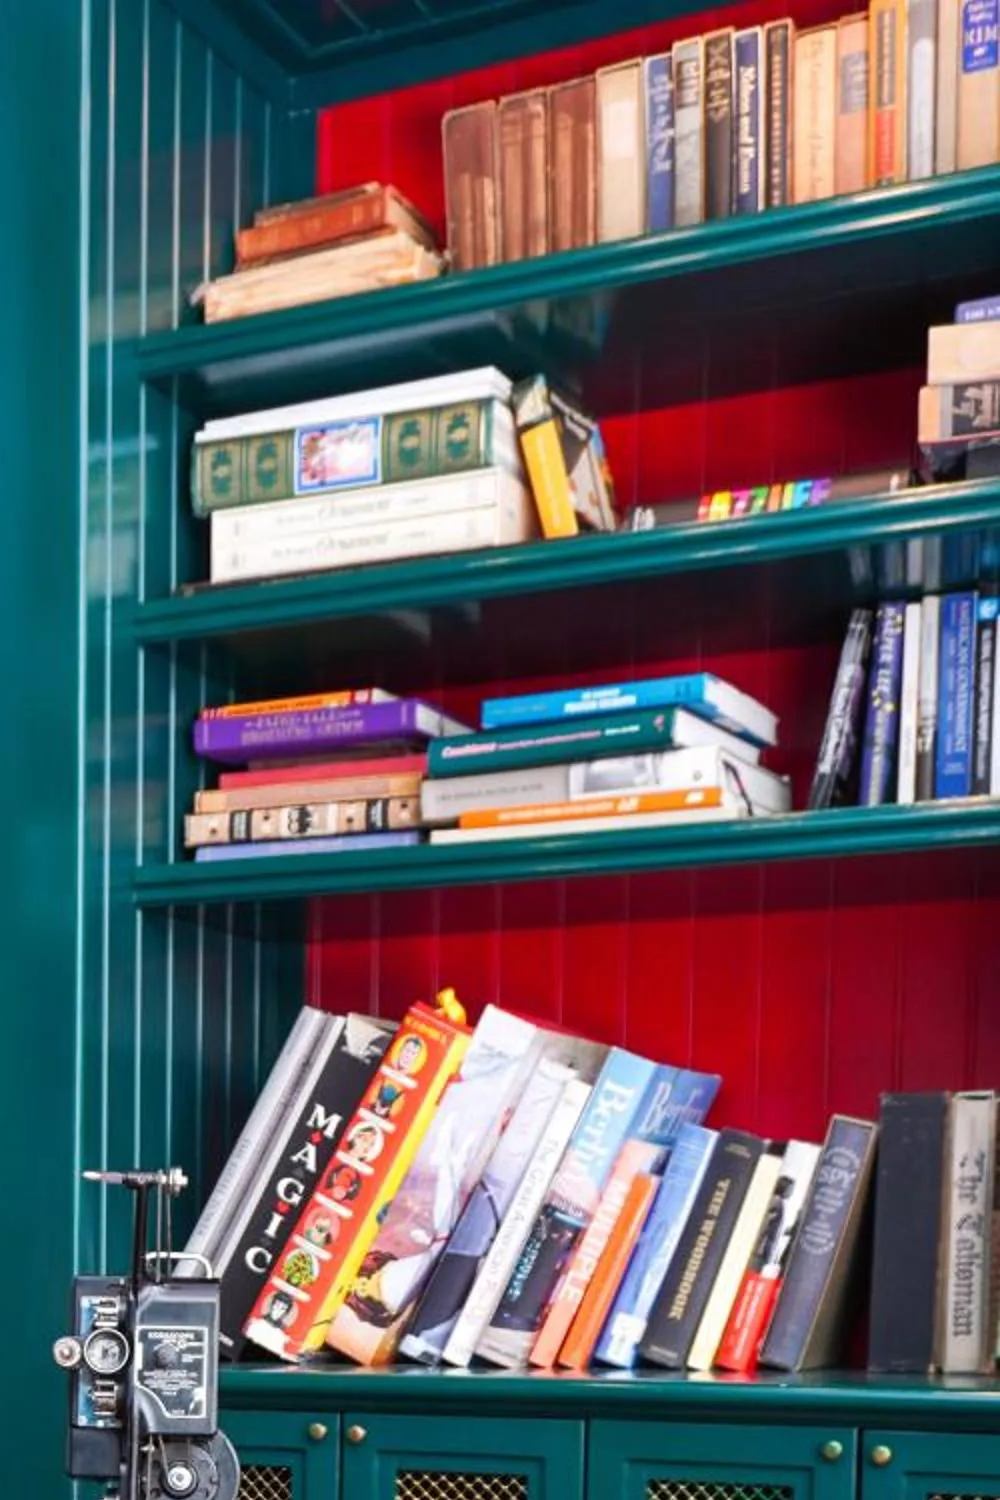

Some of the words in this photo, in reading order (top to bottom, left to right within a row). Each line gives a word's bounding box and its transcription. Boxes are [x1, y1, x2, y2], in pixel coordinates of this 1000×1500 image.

[245, 1104, 343, 1273] MAGIC
[707, 1177, 731, 1216] THE
[957, 1152, 986, 1206] The
[668, 1216, 717, 1321] WOODBOOK
[952, 1213, 985, 1338] Talisman
